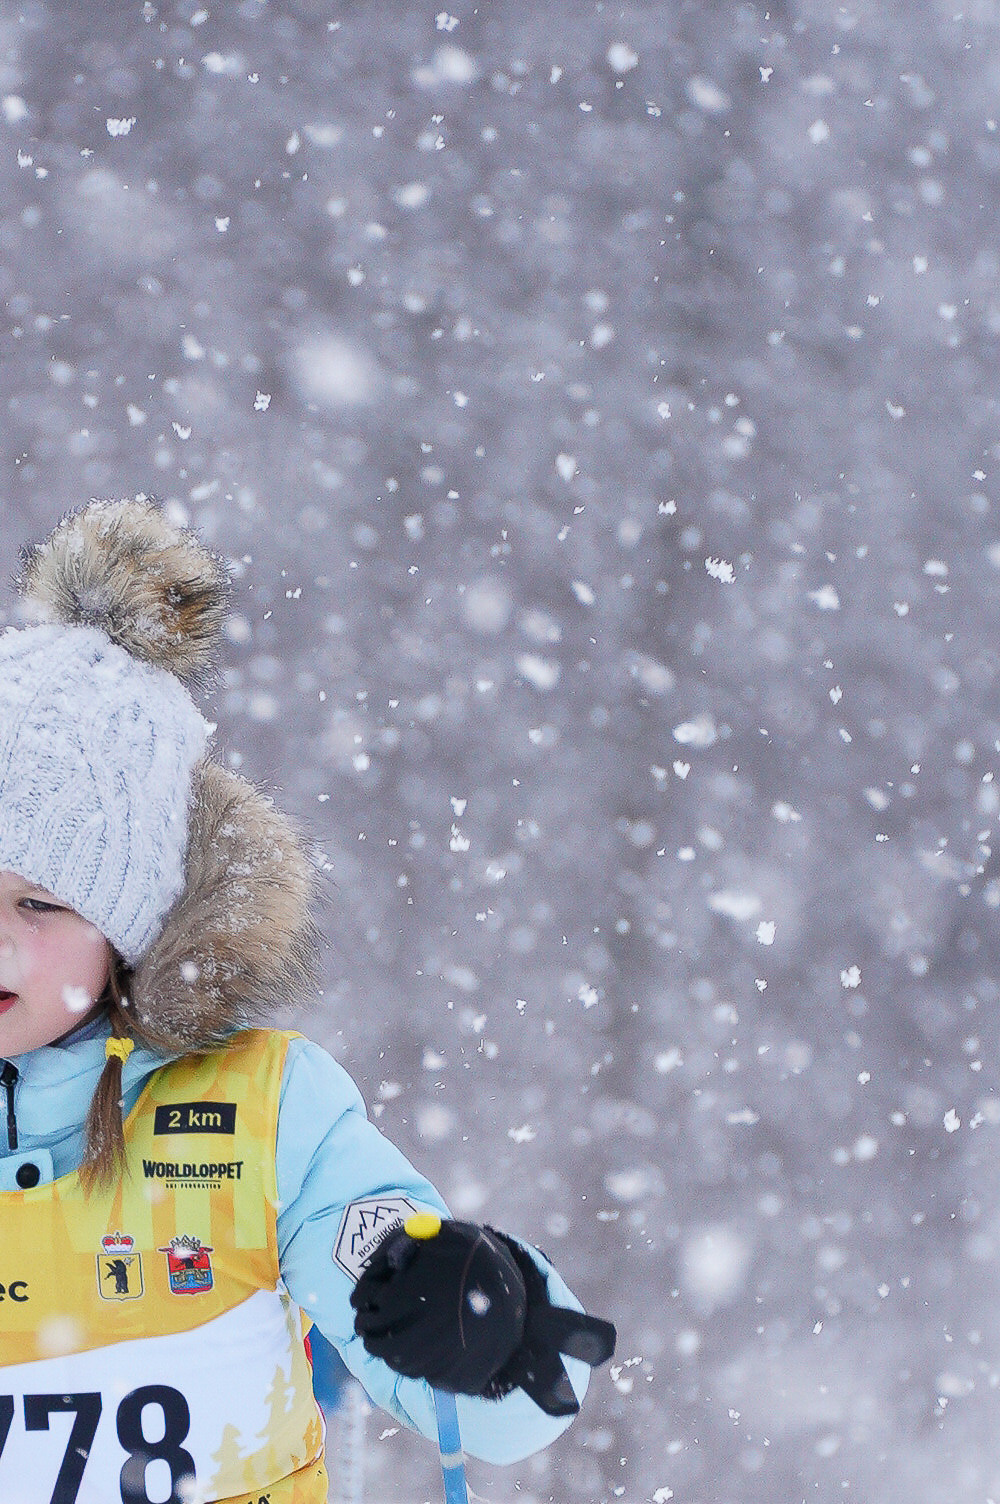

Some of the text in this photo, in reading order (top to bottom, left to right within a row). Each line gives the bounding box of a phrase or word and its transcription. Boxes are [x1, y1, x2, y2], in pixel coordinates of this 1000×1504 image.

[168, 1109, 221, 1128] 2 km
[142, 1159, 244, 1180] WORLDLOPPET
